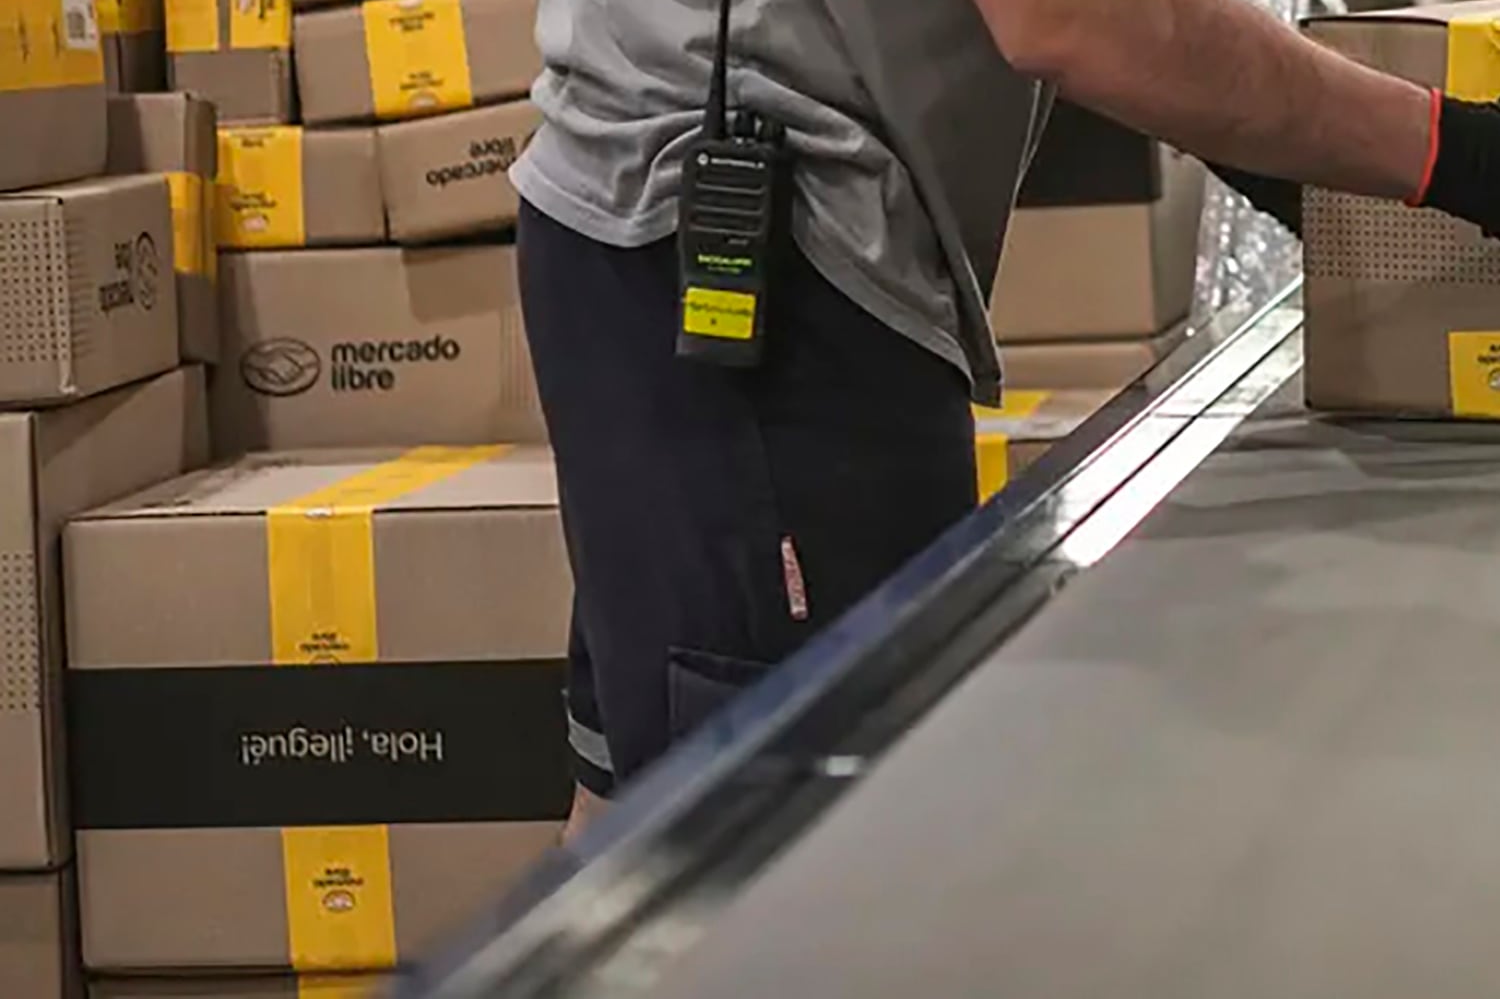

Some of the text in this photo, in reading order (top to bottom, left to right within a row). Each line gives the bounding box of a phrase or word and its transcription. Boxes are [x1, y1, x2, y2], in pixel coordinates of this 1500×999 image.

[331, 333, 460, 363] mercado
[331, 363, 395, 391] libre
[241, 726, 443, 765] Hola, ¡llegué!
